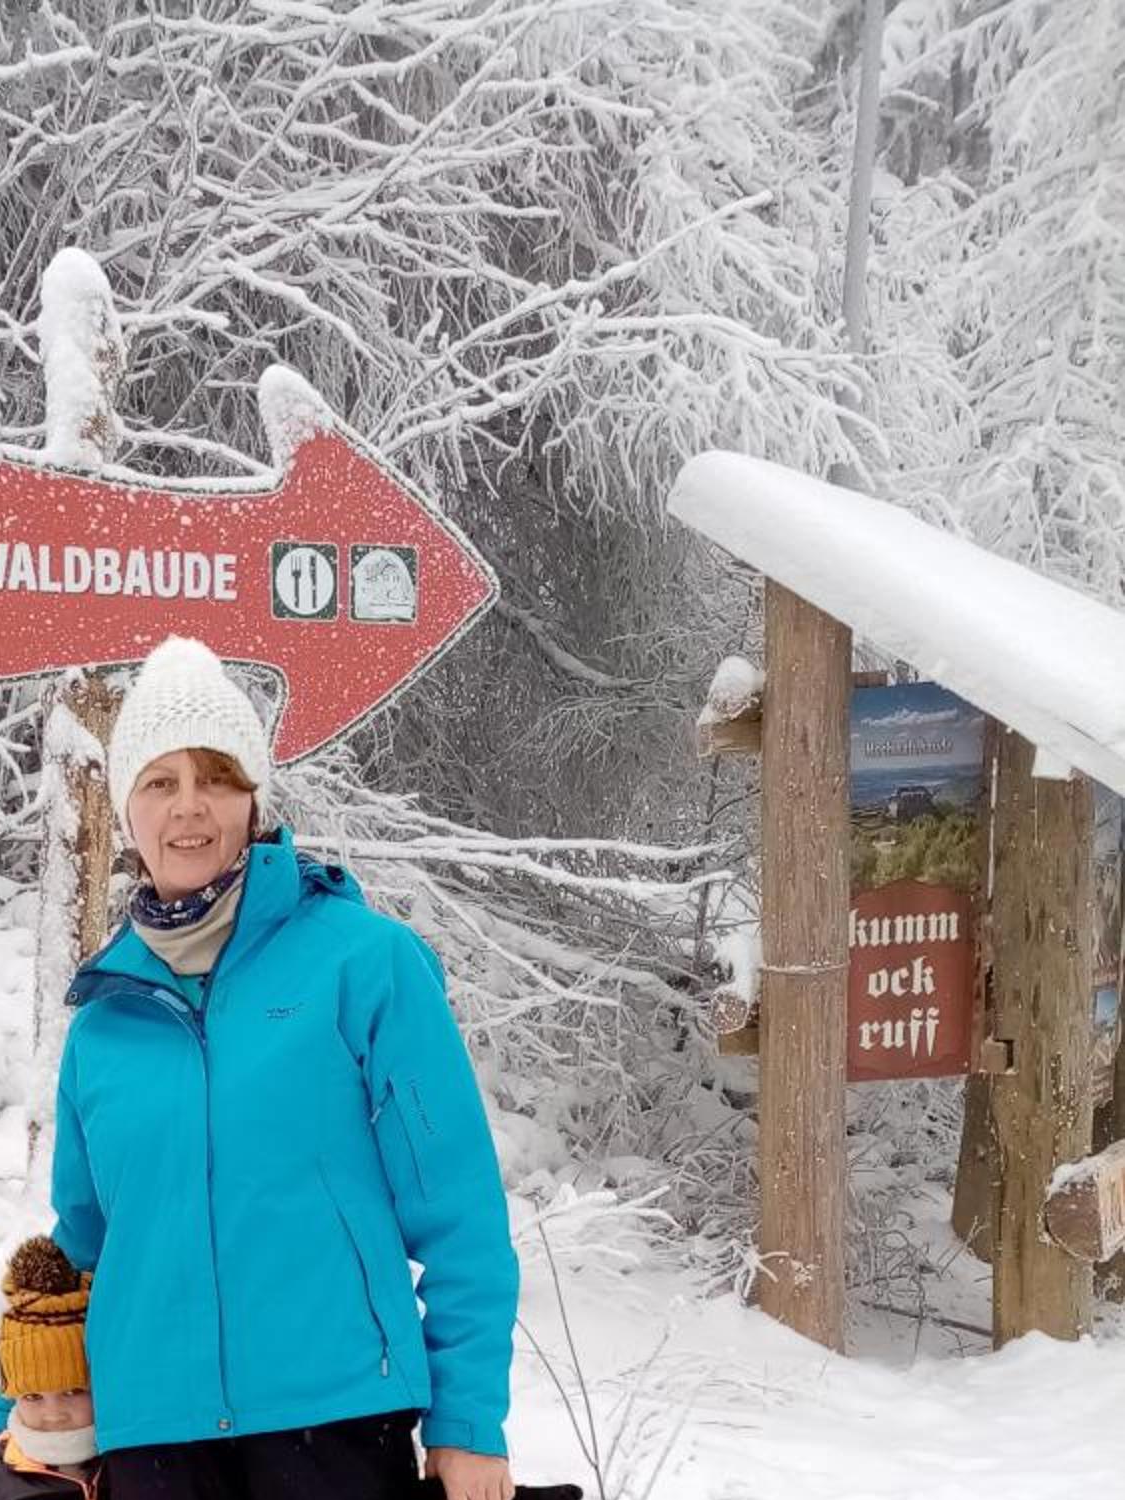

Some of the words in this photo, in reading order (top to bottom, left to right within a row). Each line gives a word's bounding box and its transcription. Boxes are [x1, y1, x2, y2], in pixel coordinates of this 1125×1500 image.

[848, 908, 960, 947] kumm
[866, 955, 937, 998] ock
[858, 1006, 941, 1058] ruff
